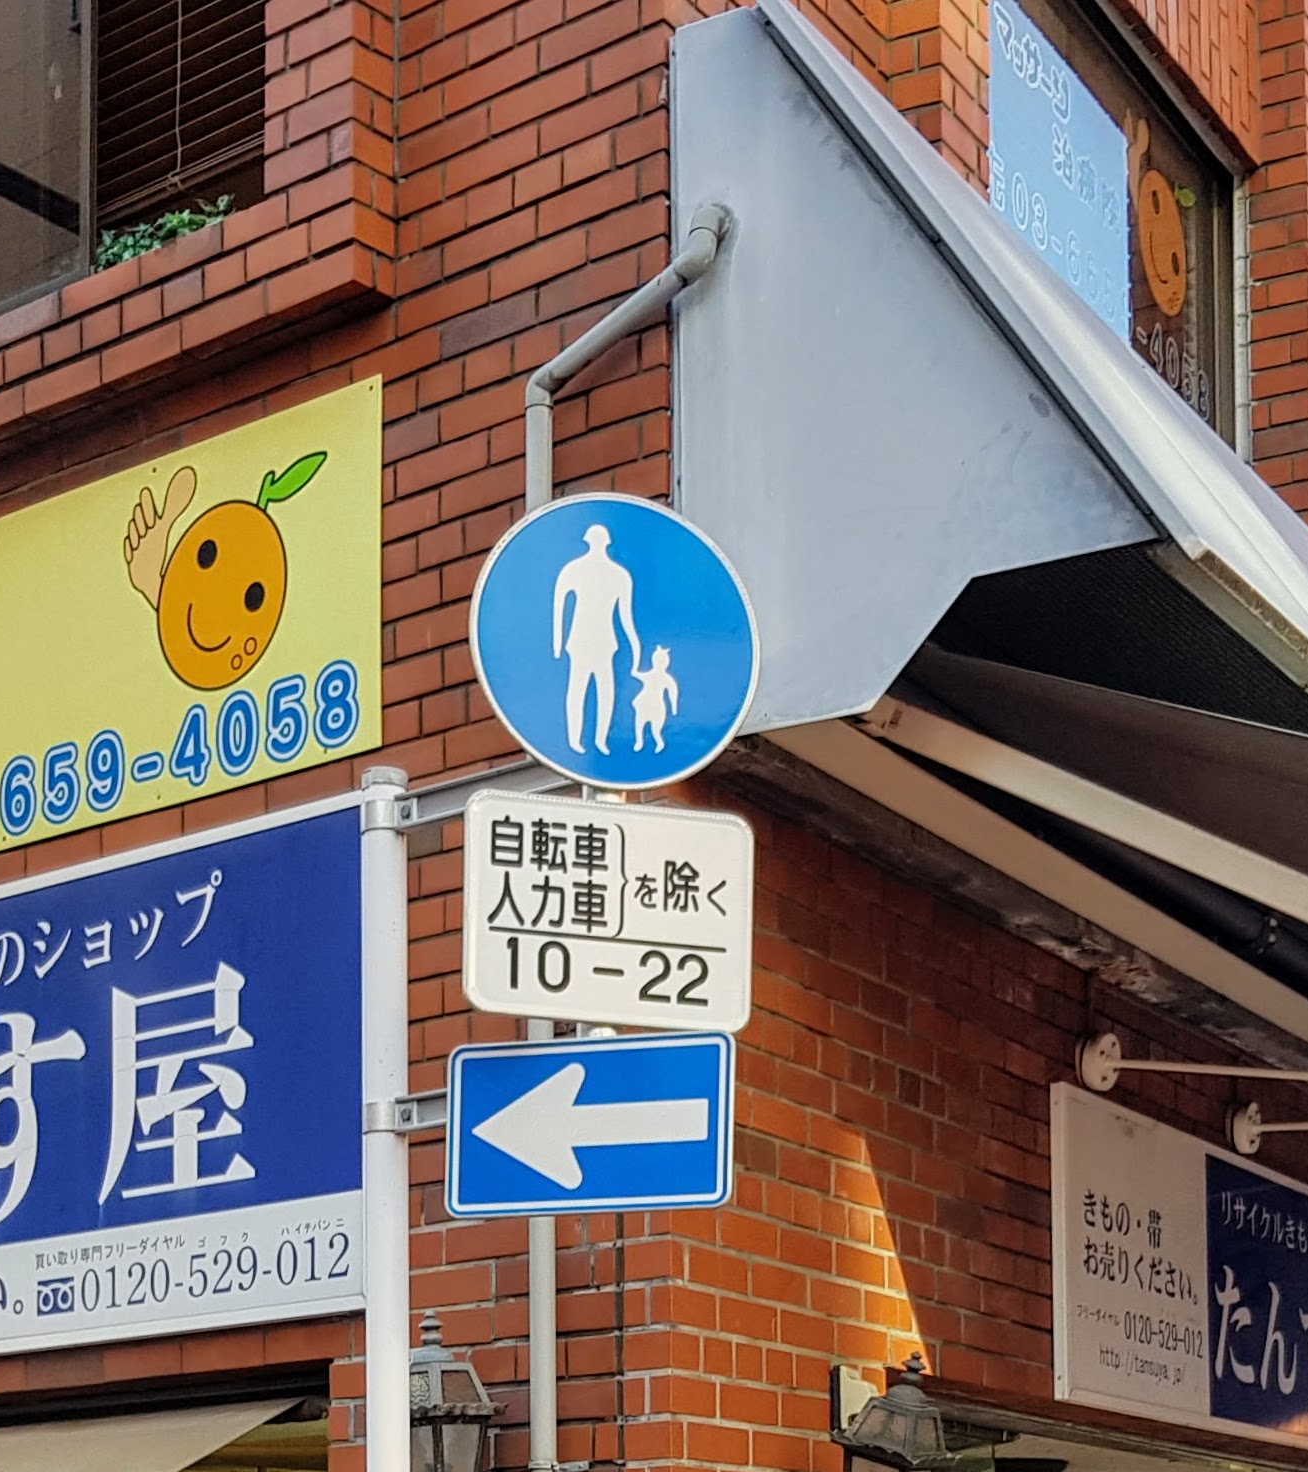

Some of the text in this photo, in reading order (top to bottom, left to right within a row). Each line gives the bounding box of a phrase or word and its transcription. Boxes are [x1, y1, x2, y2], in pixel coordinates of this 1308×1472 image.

[490, 815, 609, 877] 自転車
[487, 870, 609, 933] 人力車
[633, 860, 727, 917] を除く
[81, 1232, 351, 1312] 0120-529-012
[1083, 1236, 1199, 1305] お売りください。
[1124, 1311, 1204, 1359] 0120-529-012
